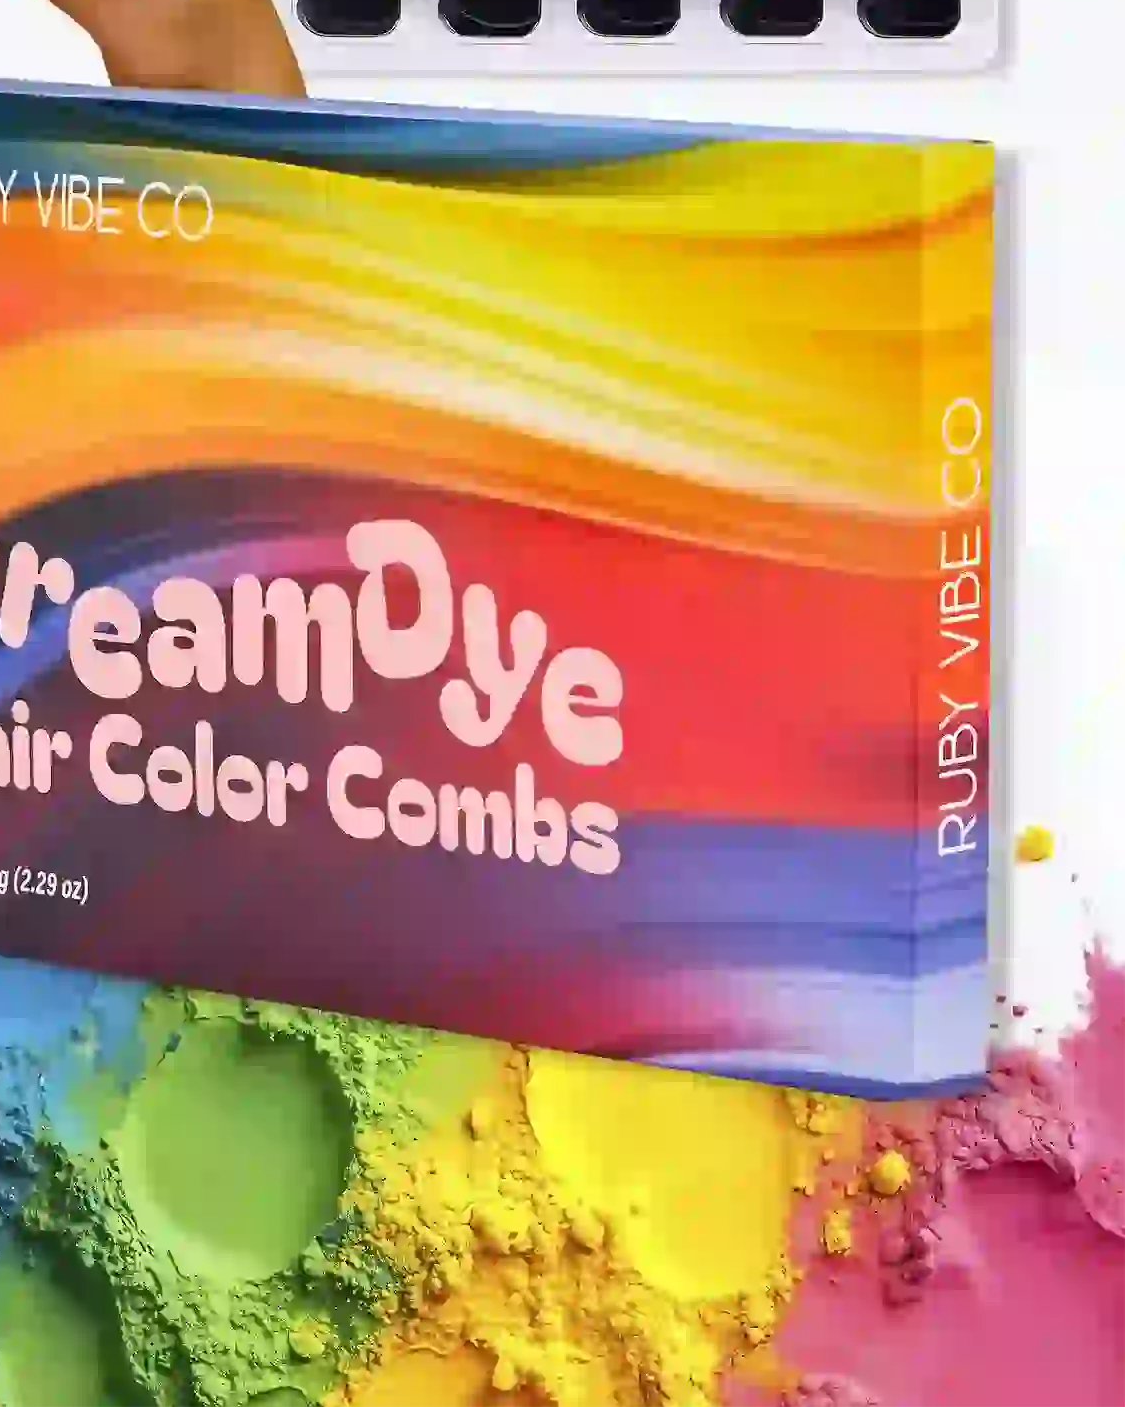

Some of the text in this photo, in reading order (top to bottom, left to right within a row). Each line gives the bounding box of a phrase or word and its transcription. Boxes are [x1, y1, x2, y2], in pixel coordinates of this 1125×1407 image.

[34, 171, 125, 234] VIBE
[137, 181, 214, 241] CO
[938, 397, 982, 857] RUBY VIBE CO
[89, 713, 309, 827] Color
[326, 745, 622, 875] Combs
[13, 865, 58, 897] (2.29
[61, 875, 89, 907] oz)
